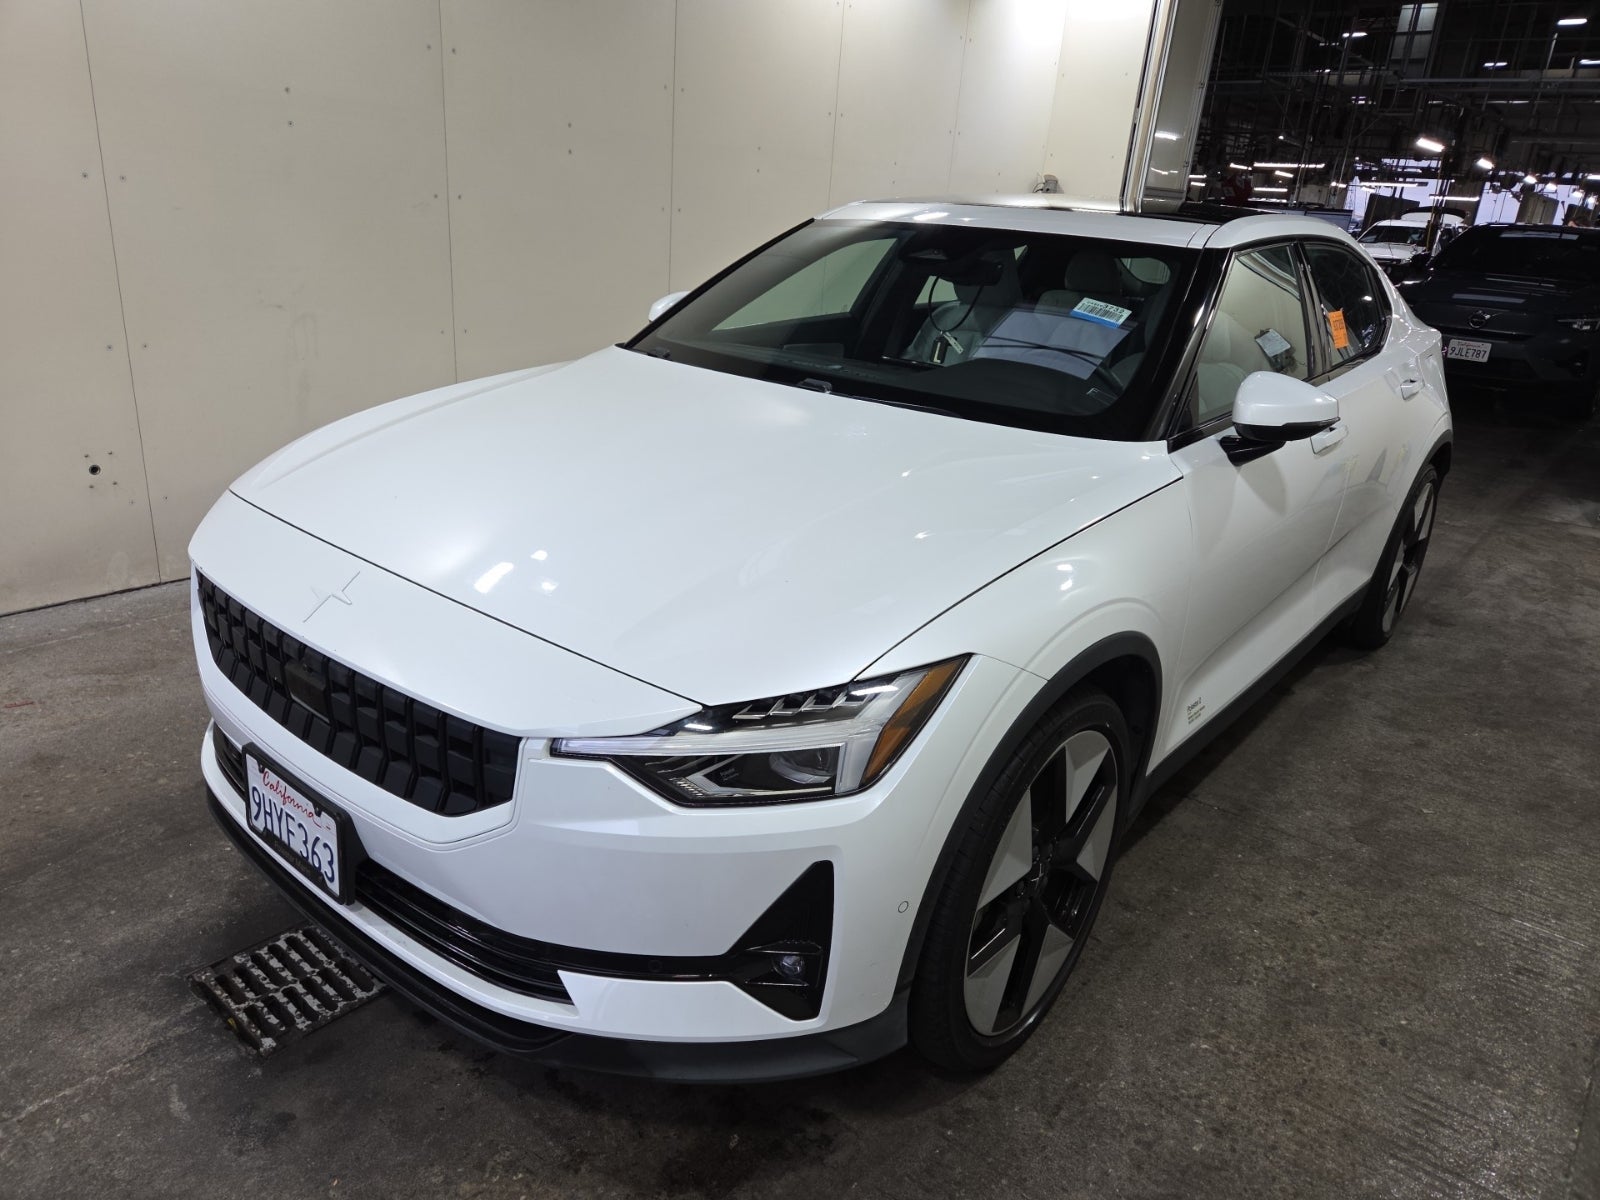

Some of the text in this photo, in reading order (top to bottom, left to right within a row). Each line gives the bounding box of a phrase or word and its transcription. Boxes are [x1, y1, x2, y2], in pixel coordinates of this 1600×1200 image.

[1449, 346, 1487, 359] 9JLE787
[262, 770, 322, 829] California
[251, 786, 335, 883] 9HYF363
